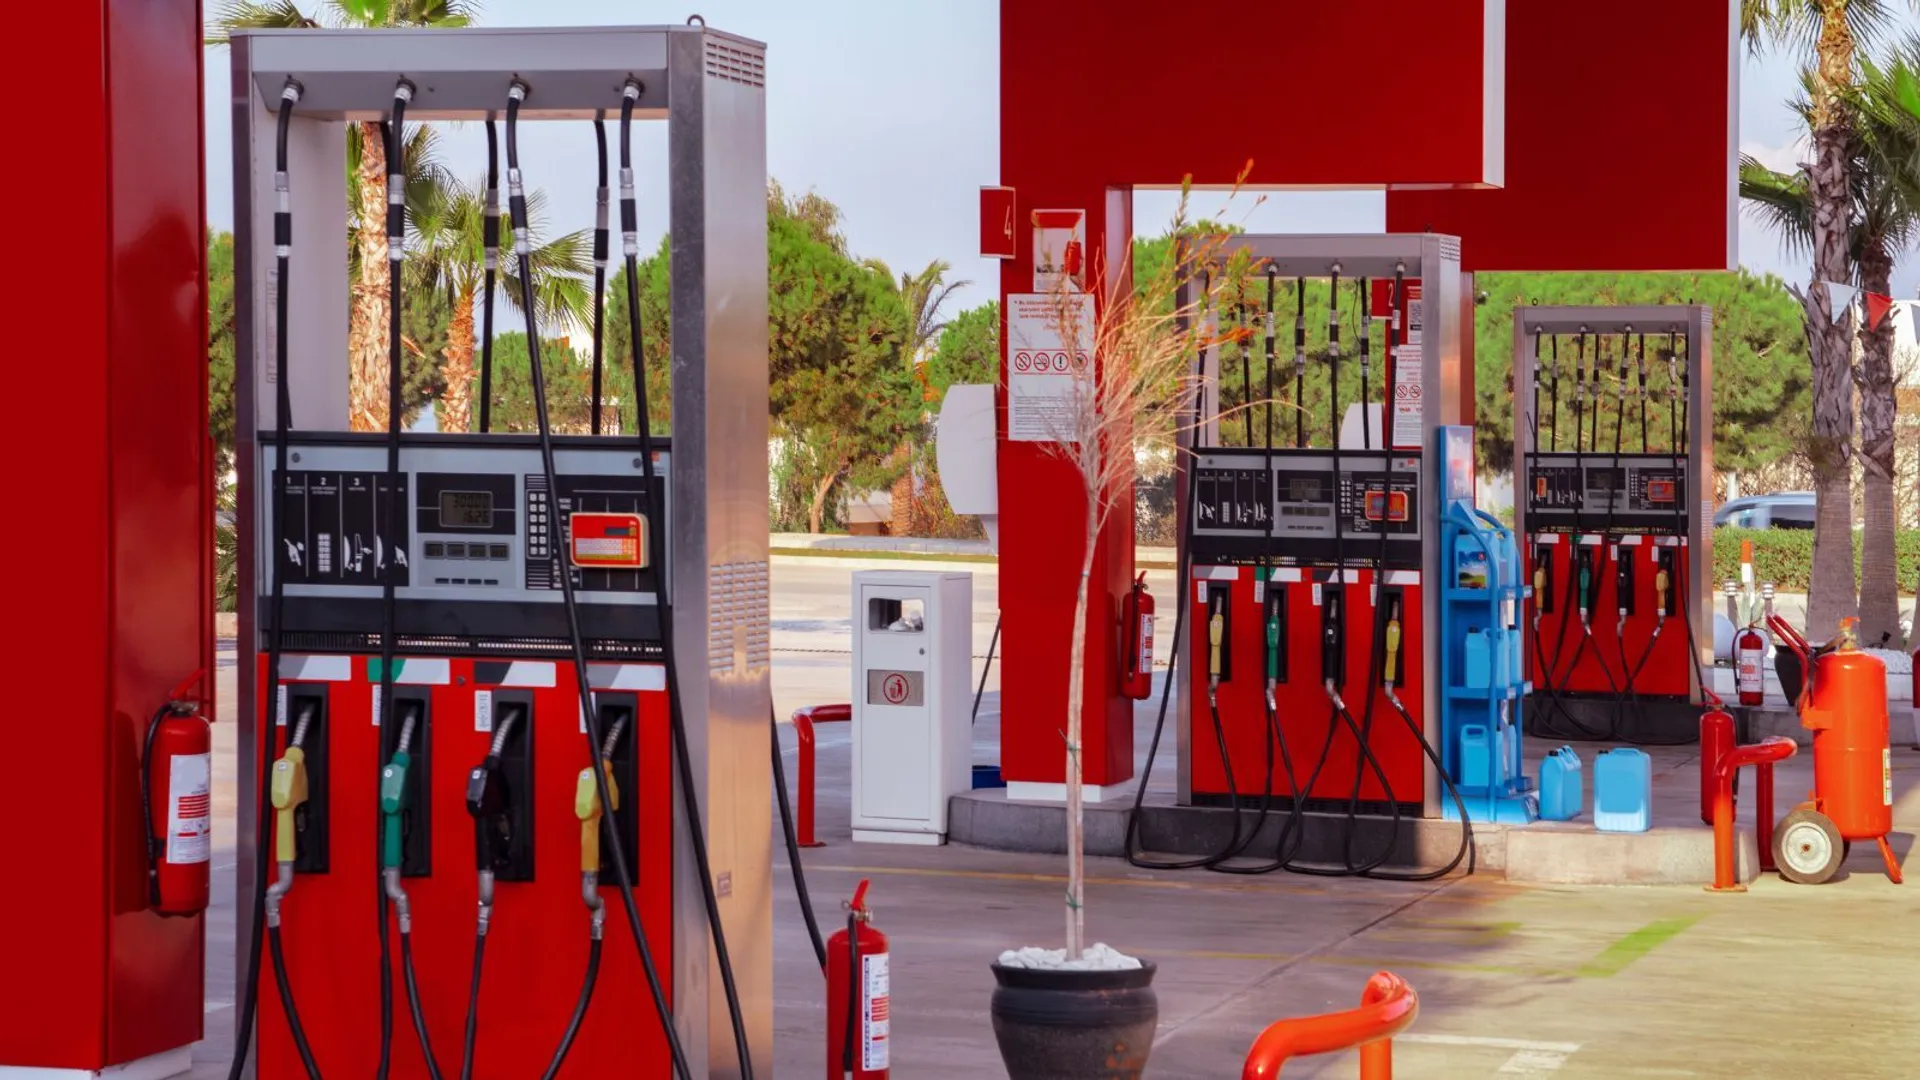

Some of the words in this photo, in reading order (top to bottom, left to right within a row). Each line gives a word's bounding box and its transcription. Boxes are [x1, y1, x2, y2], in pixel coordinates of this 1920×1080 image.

[1003, 205, 1012, 240] 4
[1388, 283, 1395, 307] 2
[320, 476, 327, 486] 2
[353, 477, 360, 487] 3
